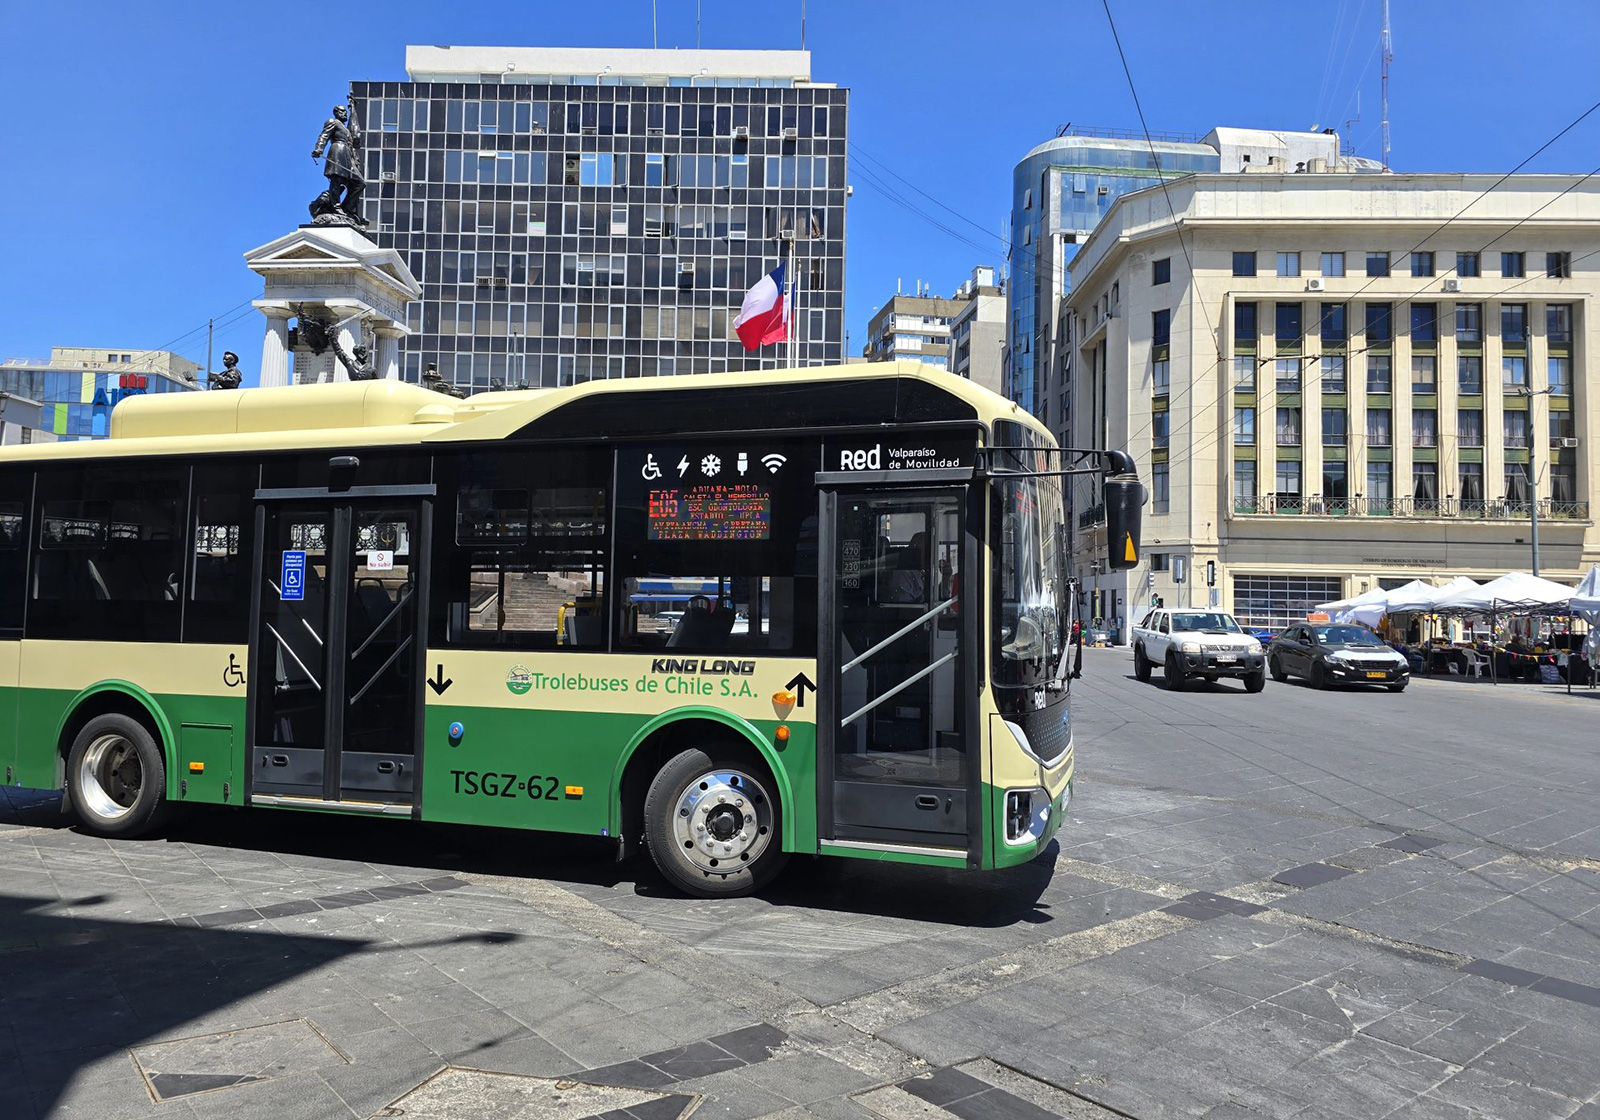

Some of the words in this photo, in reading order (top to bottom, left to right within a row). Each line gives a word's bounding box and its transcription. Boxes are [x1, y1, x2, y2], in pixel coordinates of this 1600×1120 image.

[840, 443, 880, 471] Red
[888, 447, 936, 459] Valparaíso
[888, 460, 901, 470] de
[906, 458, 960, 469] Movilidad
[690, 512, 723, 520] ESTADIO
[651, 658, 699, 675] KING
[700, 659, 756, 676] LONG
[532, 673, 628, 692] Trolebuses
[635, 675, 658, 693] de
[665, 676, 713, 696] Chile
[720, 679, 759, 699] S.A.
